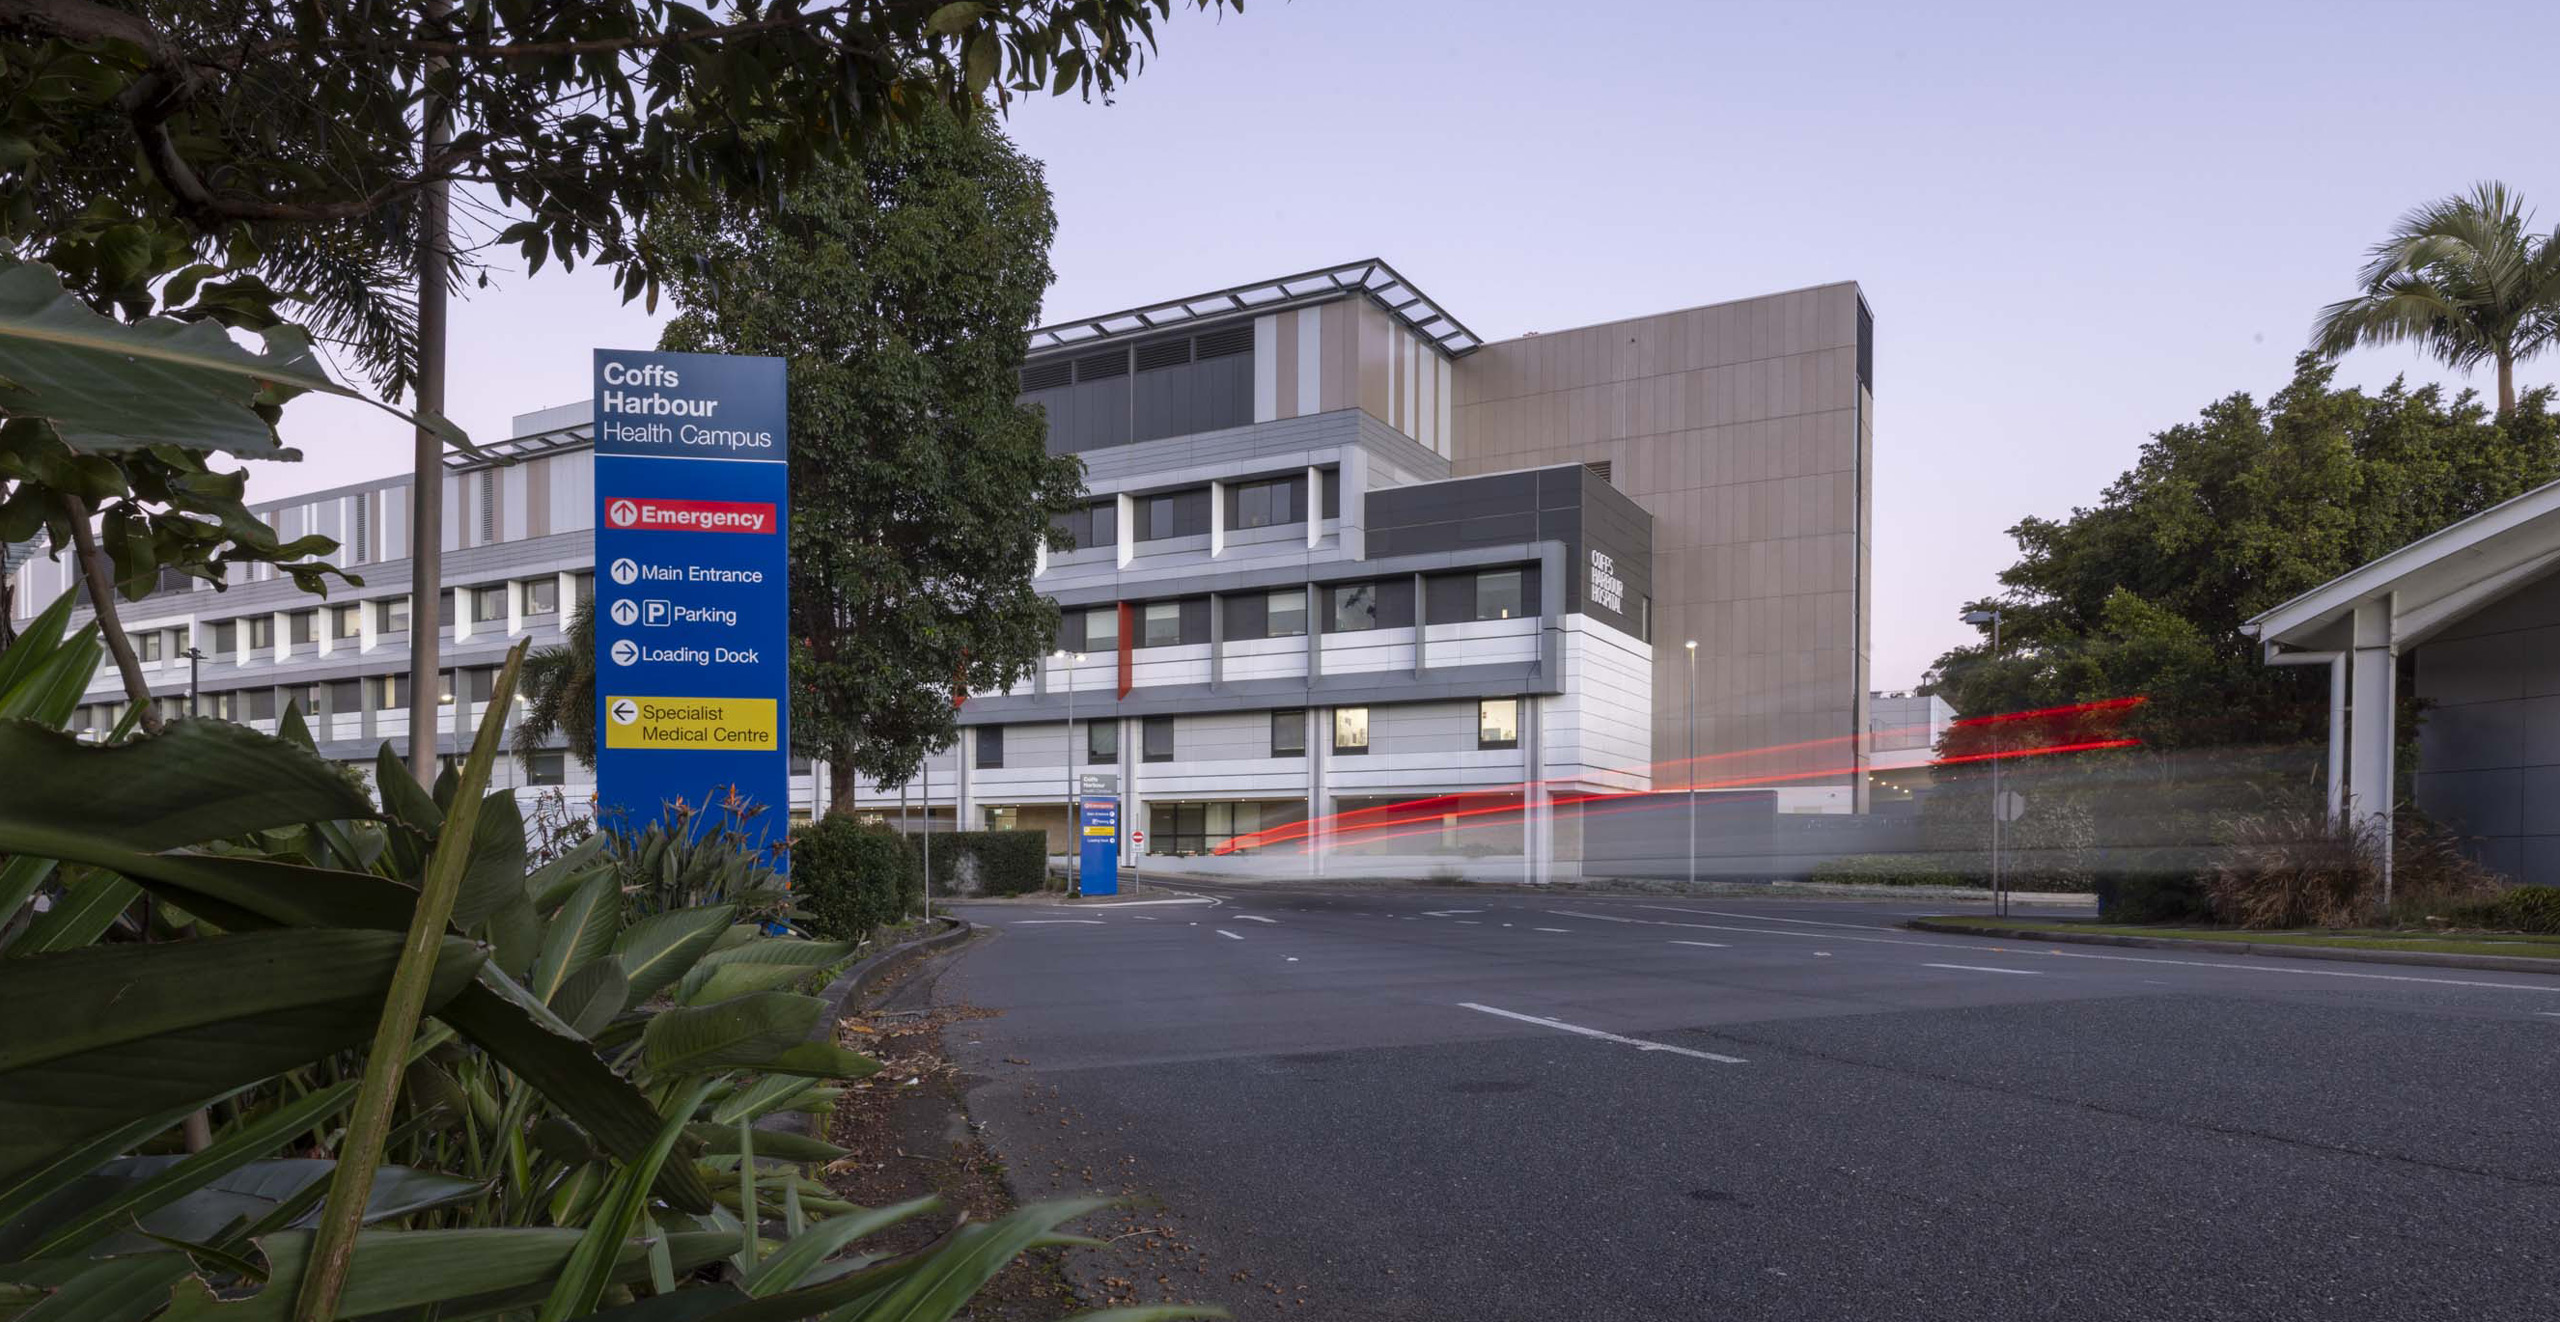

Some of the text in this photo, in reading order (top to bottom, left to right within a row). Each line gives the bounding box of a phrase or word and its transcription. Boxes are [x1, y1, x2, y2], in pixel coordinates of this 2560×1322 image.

[603, 362, 679, 387] Coffs
[603, 390, 718, 417] Harbour
[603, 421, 772, 450] Health Campus
[641, 505, 764, 530] Emergency
[642, 565, 763, 583] Main Entrance
[1592, 549, 1614, 575] COFFS
[1591, 566, 1624, 599] HARBOUR
[1591, 584, 1623, 615] HOSPITAL
[674, 606, 737, 626] Parking
[642, 646, 759, 666] Loading Dock
[643, 704, 723, 723] Specialist
[642, 726, 769, 743] Medical Centre
